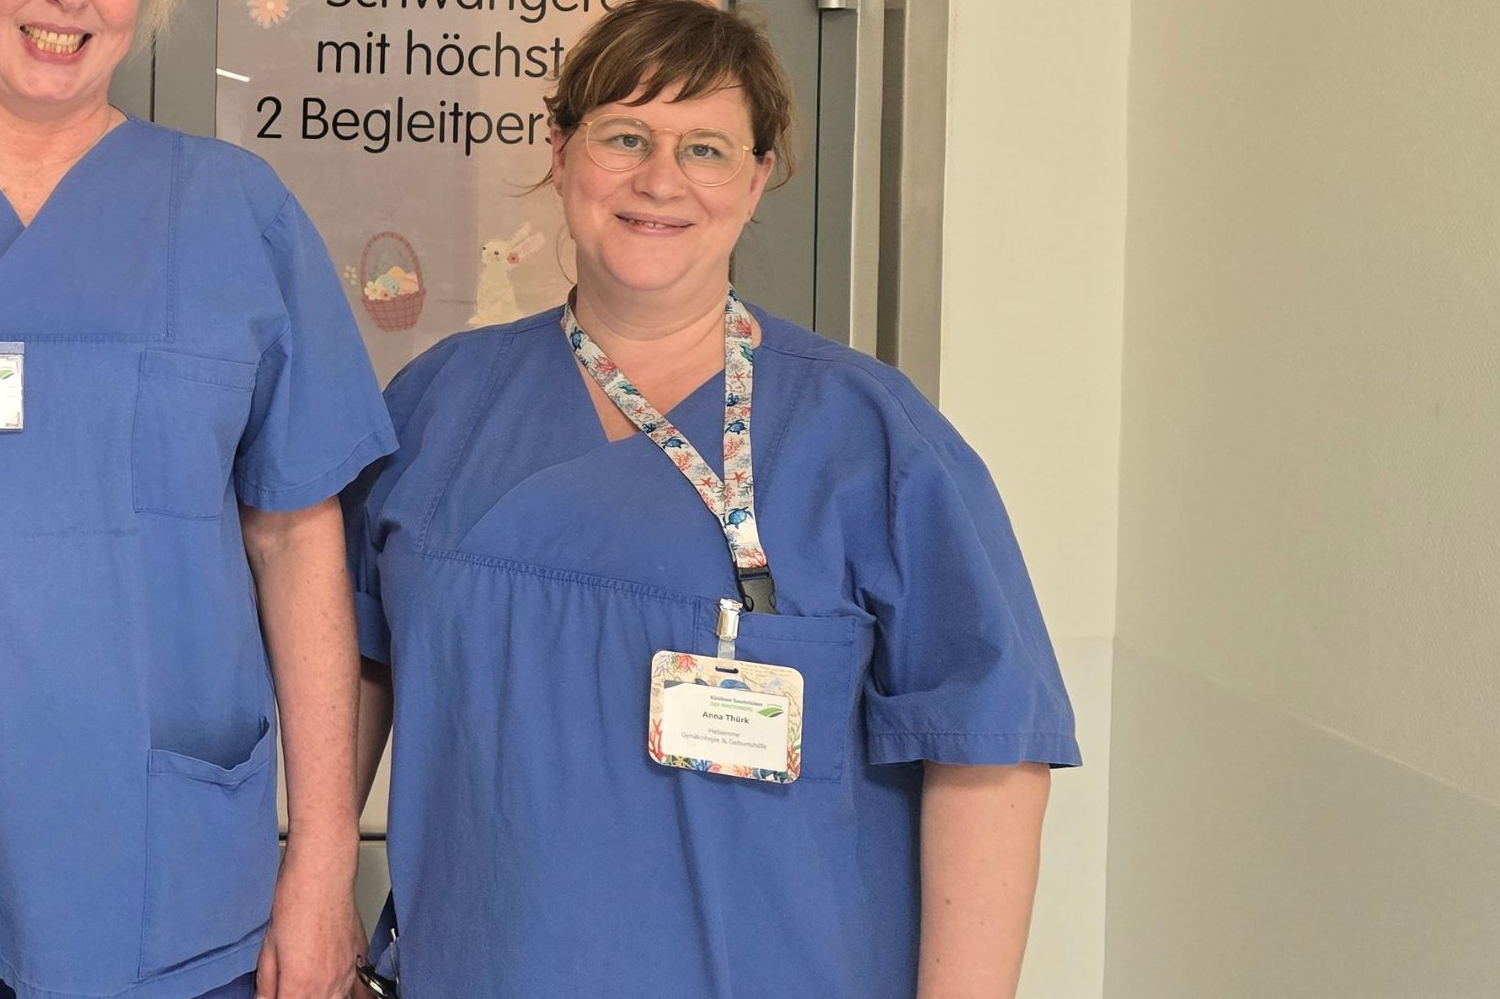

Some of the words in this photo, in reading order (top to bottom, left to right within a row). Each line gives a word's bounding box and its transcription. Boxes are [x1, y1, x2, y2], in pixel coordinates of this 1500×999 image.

[317, 29, 392, 76] mit
[256, 96, 284, 140] 2
[301, 95, 553, 158] Begleitper
[702, 711, 723, 720] Anna
[726, 714, 750, 724] Thürk
